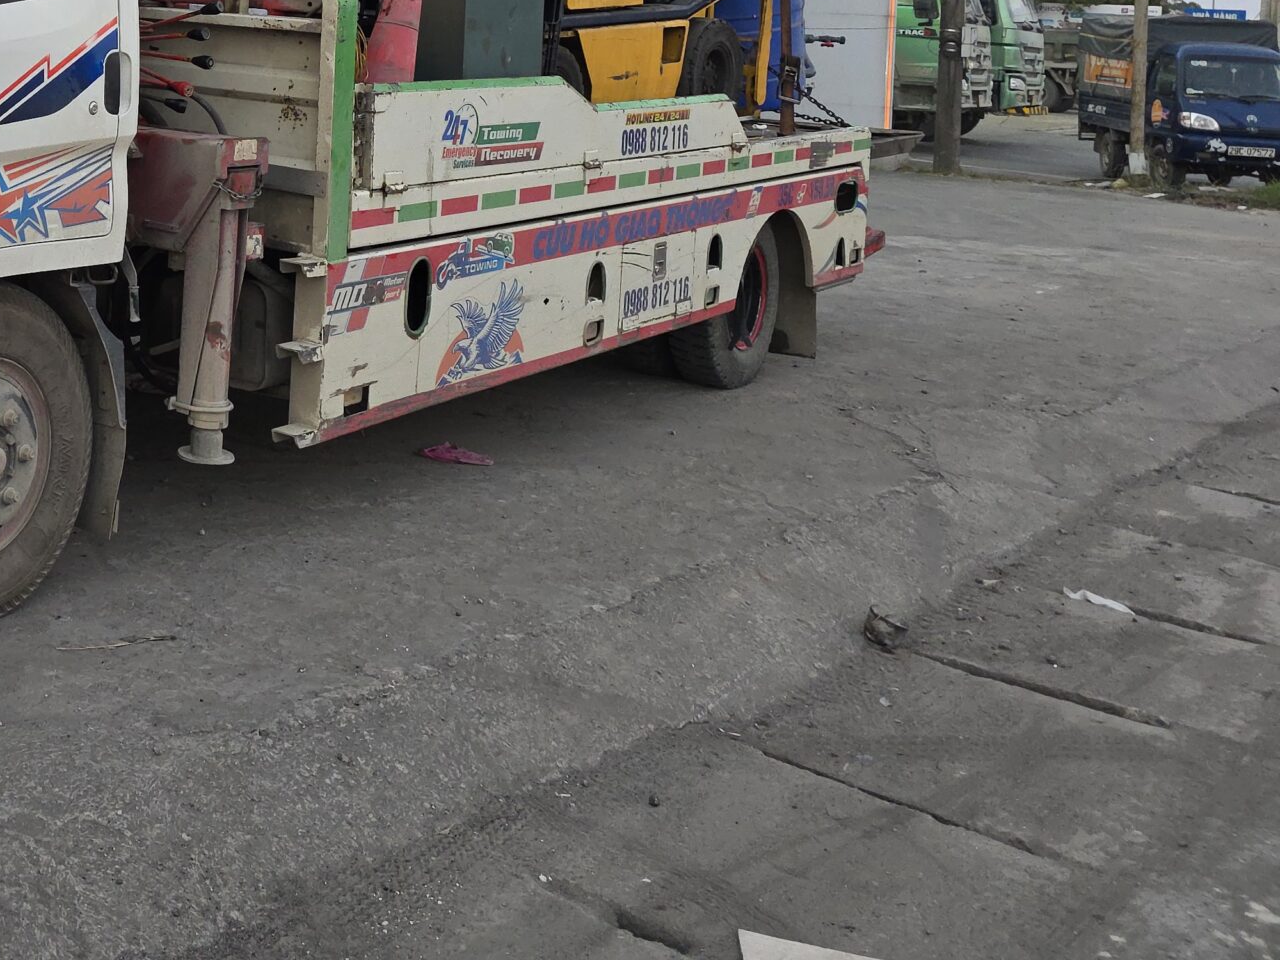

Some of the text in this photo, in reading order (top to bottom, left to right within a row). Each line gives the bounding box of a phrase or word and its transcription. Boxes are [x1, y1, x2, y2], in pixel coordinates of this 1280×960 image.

[481, 126, 523, 141] Towing
[621, 123, 688, 156] 0988 812 116
[480, 147, 537, 162] Recovery
[614, 209, 662, 243] GIAO
[464, 259, 498, 274] TOWING
[624, 275, 690, 318] 0988 812 116
